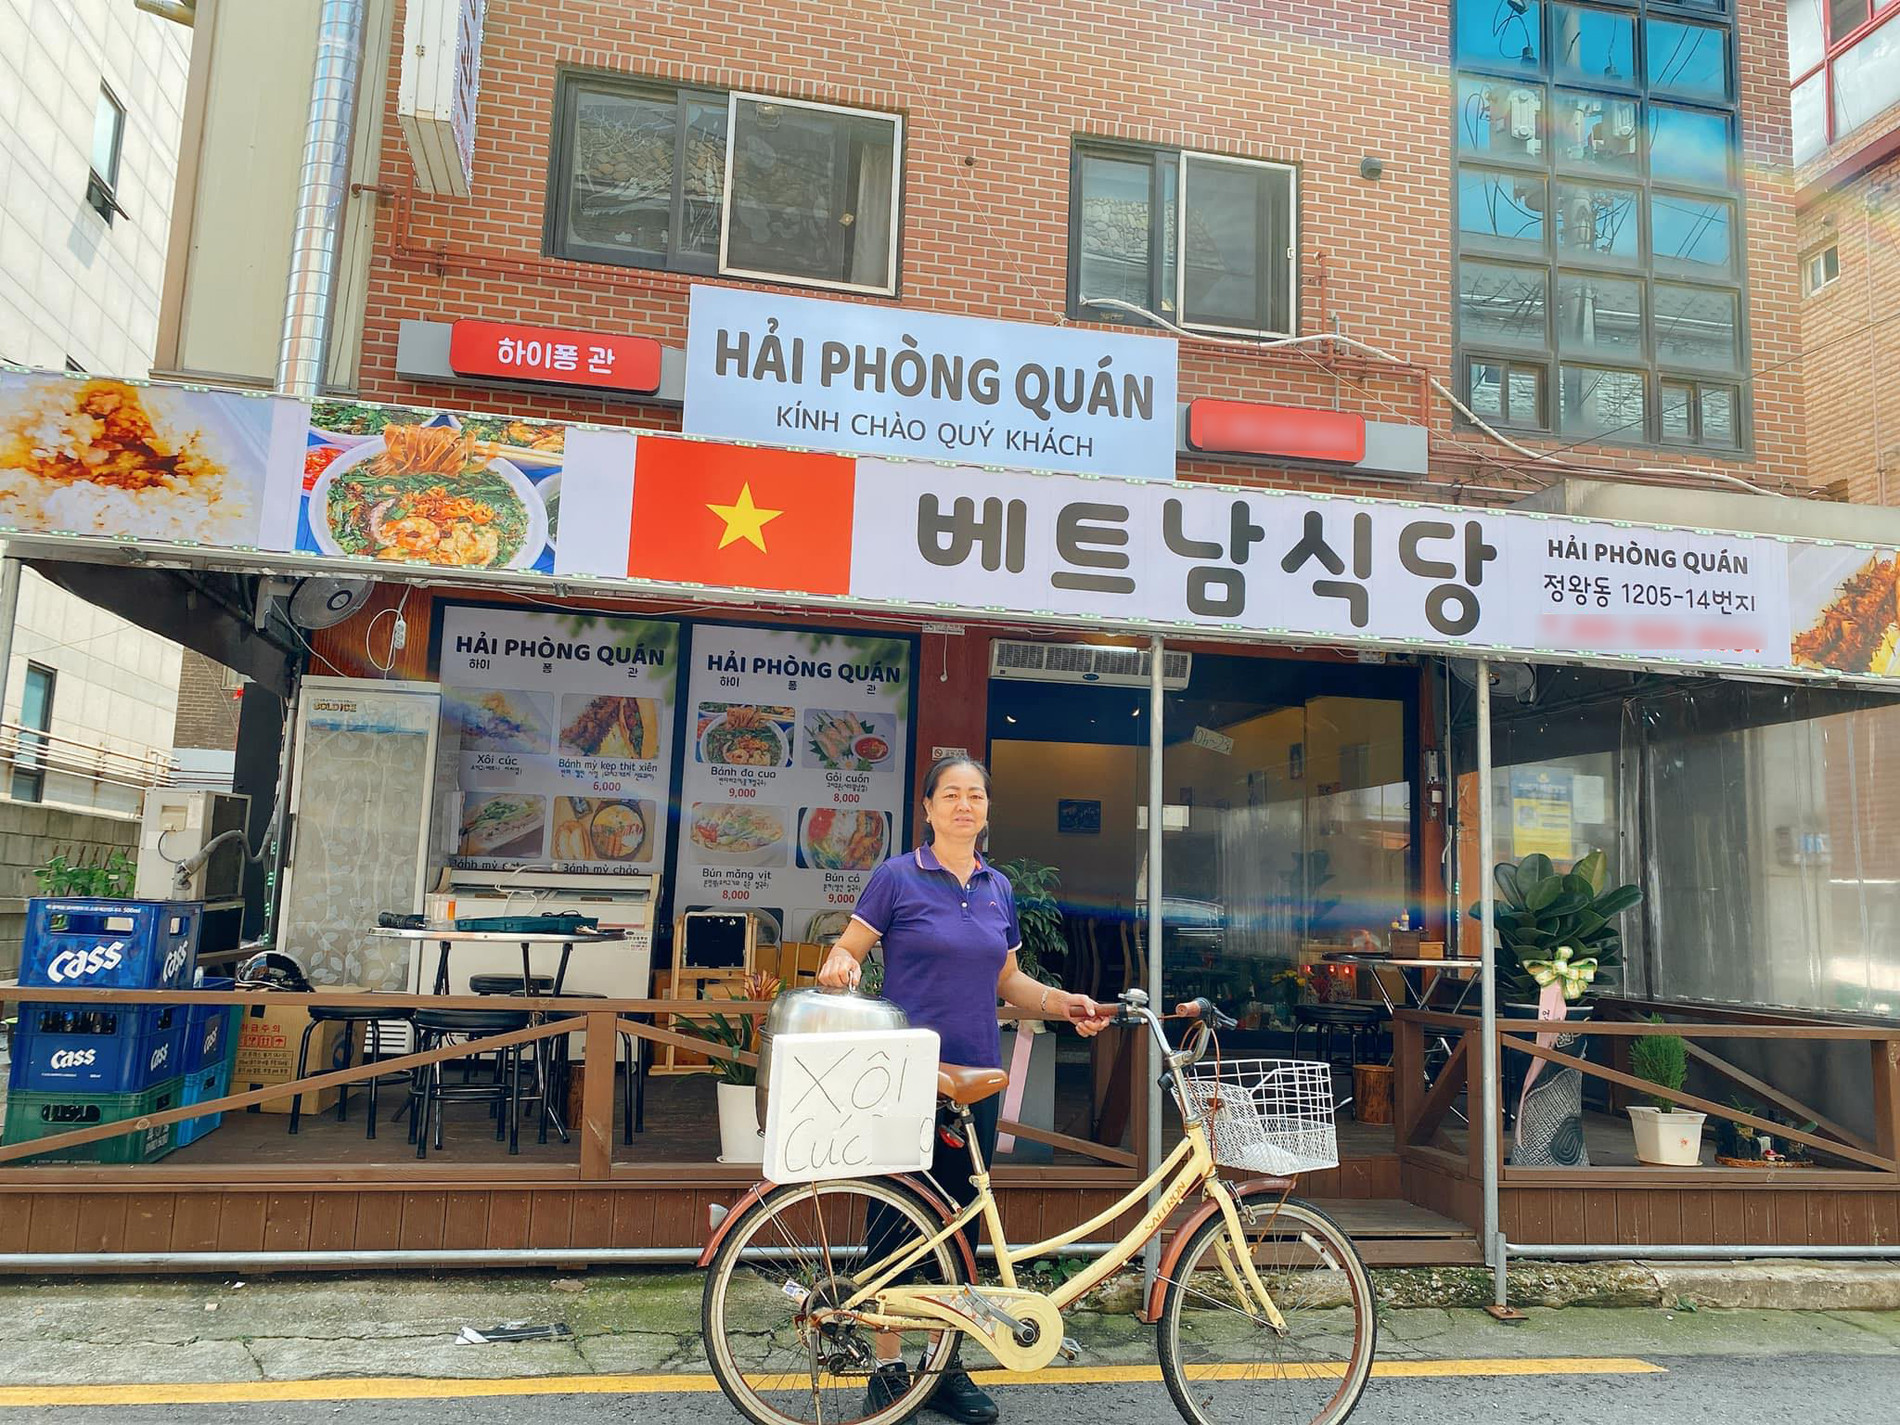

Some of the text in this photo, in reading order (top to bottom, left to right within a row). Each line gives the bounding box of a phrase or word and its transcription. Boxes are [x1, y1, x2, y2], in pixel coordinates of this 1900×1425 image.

[498, 337, 615, 374] 하이퐁 관
[715, 317, 1153, 421] HẢI PHÒNG QUÁN
[776, 401, 1093, 457] KÍNH CHÀO QUÝ KHÁCH
[1548, 535, 1748, 575] HẢI PHÒNG QUÁN
[917, 492, 1498, 636] 베트남식당
[1544, 574, 1755, 615] 정왕동 1205-14번지
[456, 631, 664, 666] HẢI PHÒNG QUÁN
[469, 658, 490, 670] 하이
[708, 650, 900, 683] HẢI PHÒNG QUÁN
[719, 676, 740, 687] 하이
[477, 754, 518, 765] Xôi cúc
[558, 758, 581, 768] Bánh
[711, 766, 737, 776] Bánh
[593, 781, 621, 791] 6,000
[729, 787, 756, 798] 9,000
[833, 793, 860, 803] 8,000
[702, 868, 722, 878] Bún
[726, 868, 754, 880] măng
[825, 872, 844, 882] Bún
[722, 890, 750, 900] 8,000
[828, 893, 855, 904] 9,000
